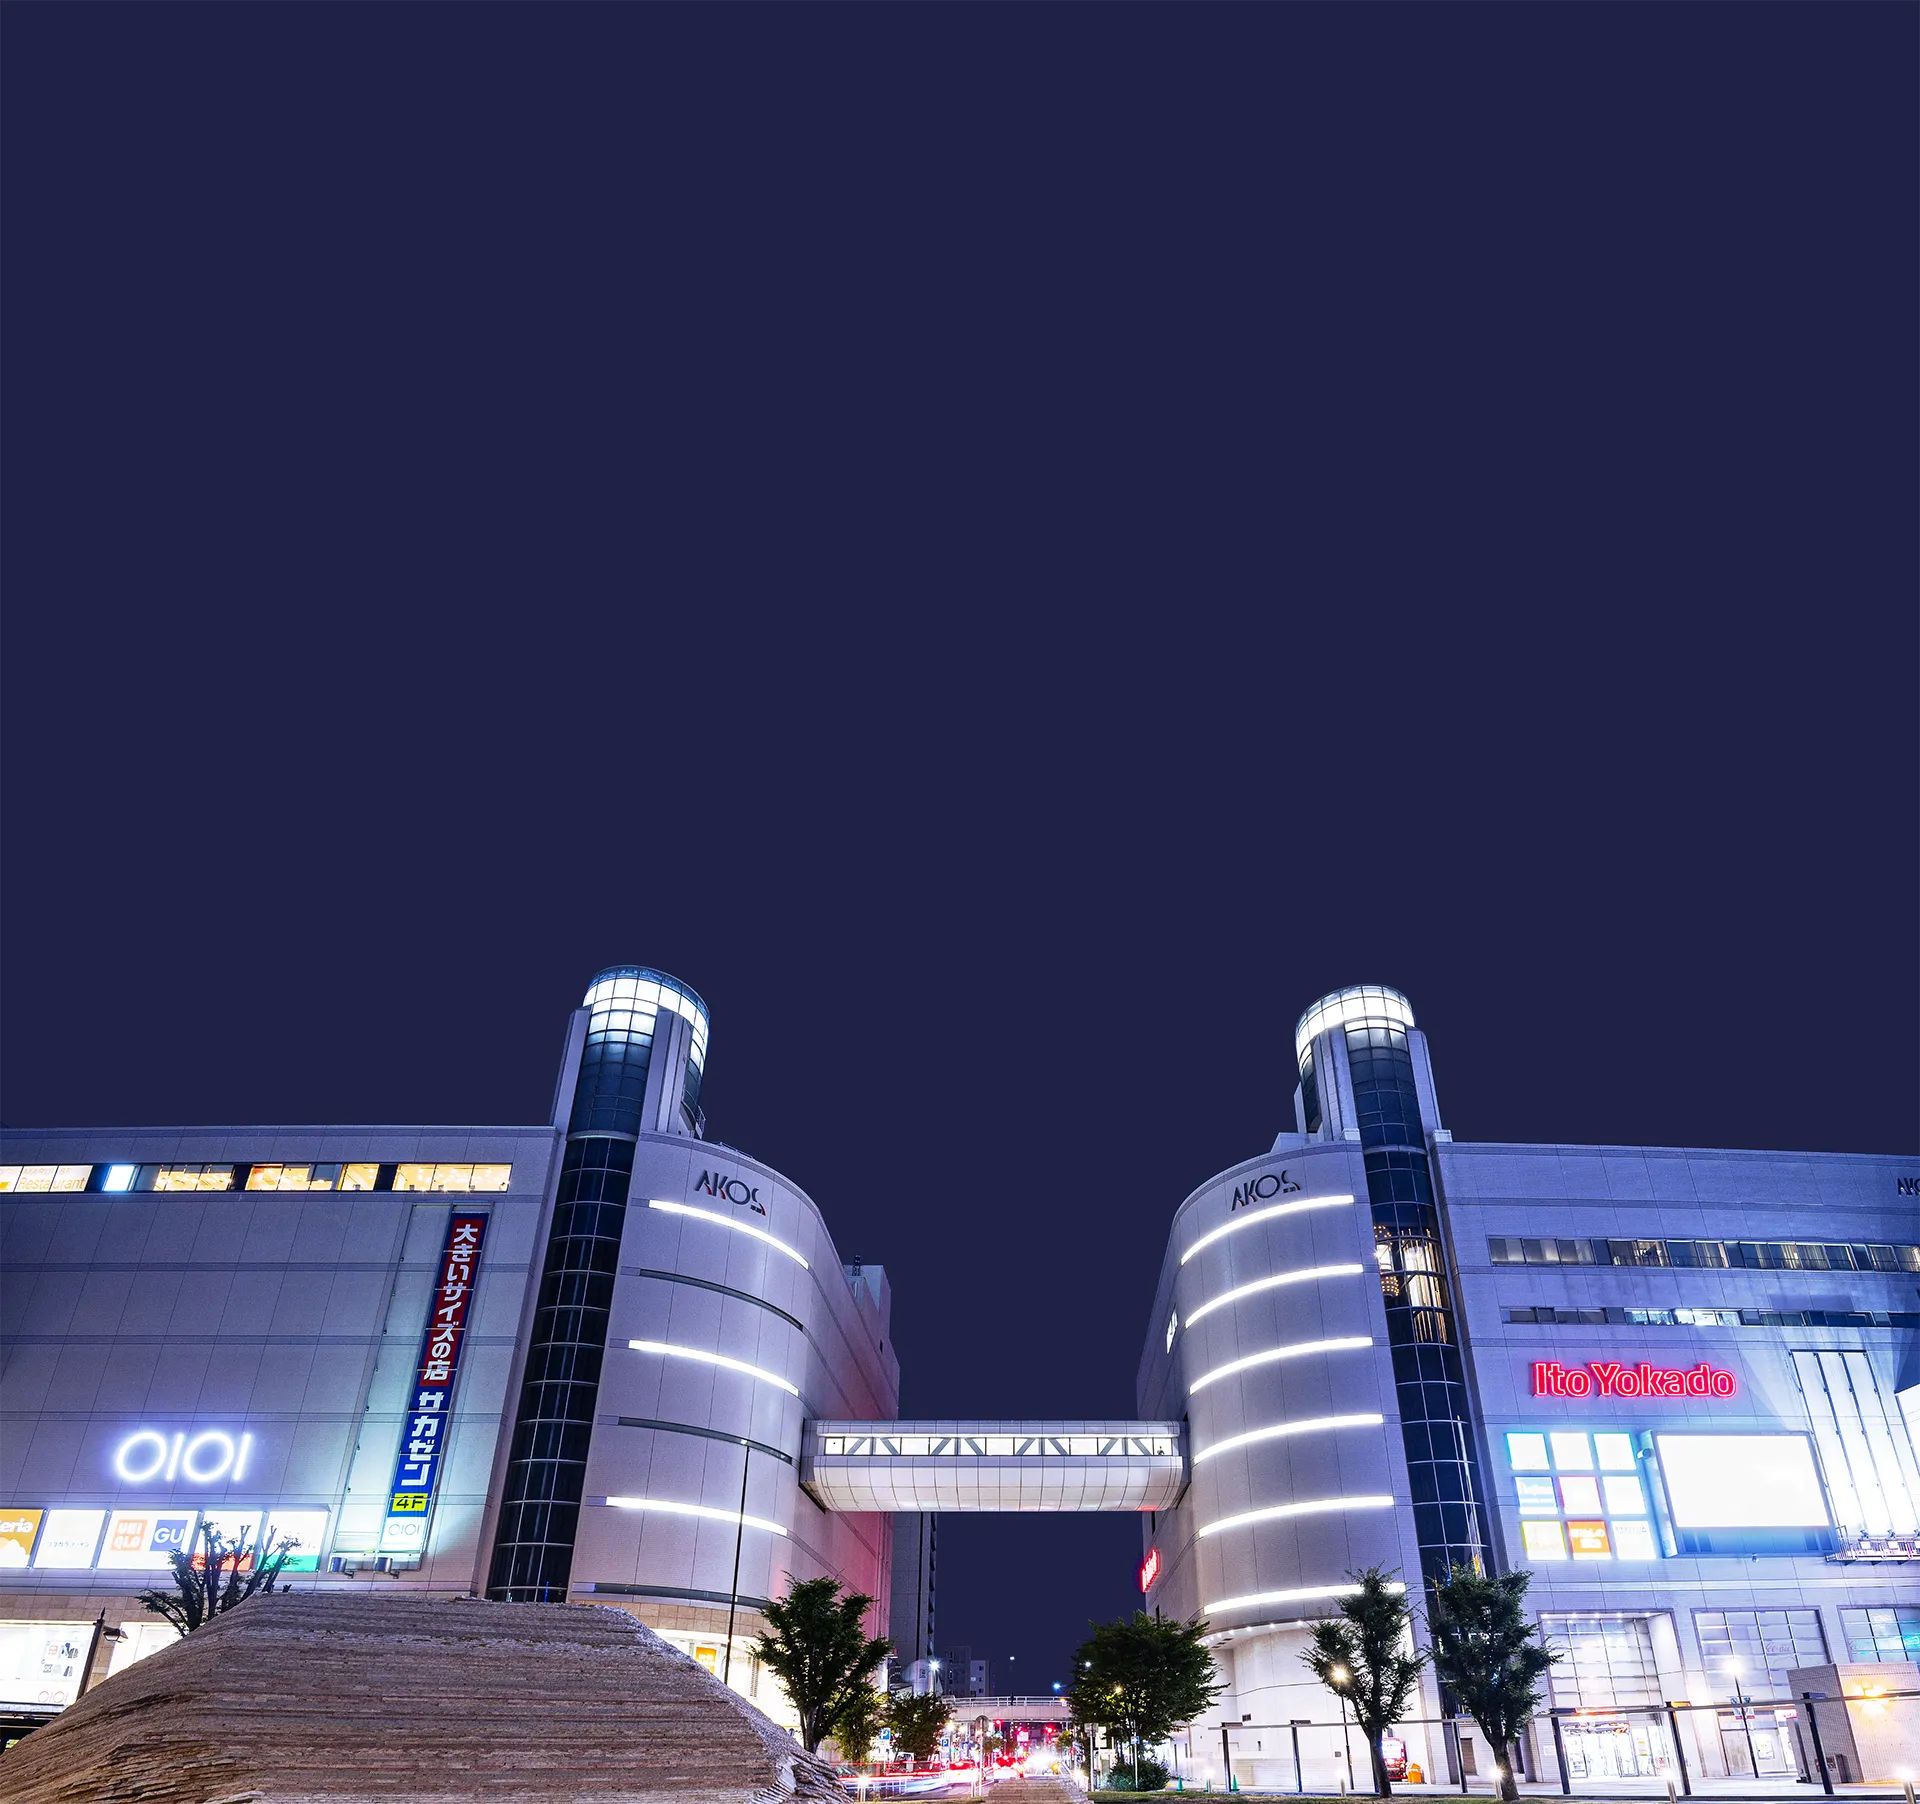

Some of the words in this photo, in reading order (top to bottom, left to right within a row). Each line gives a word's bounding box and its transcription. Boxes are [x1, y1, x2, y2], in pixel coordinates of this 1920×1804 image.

[18, 1177, 85, 1190] Restaurant
[1231, 1170, 1301, 1212] AKOS
[694, 1170, 767, 1216] AKOS
[423, 1223, 478, 1381] 大きいサイズの店
[401, 1391, 445, 1486] サカゼン
[396, 1495, 424, 1509] 4F
[0, 1517, 34, 1533] eria
[113, 1535, 142, 1550] QLO
[153, 1527, 185, 1543] GU
